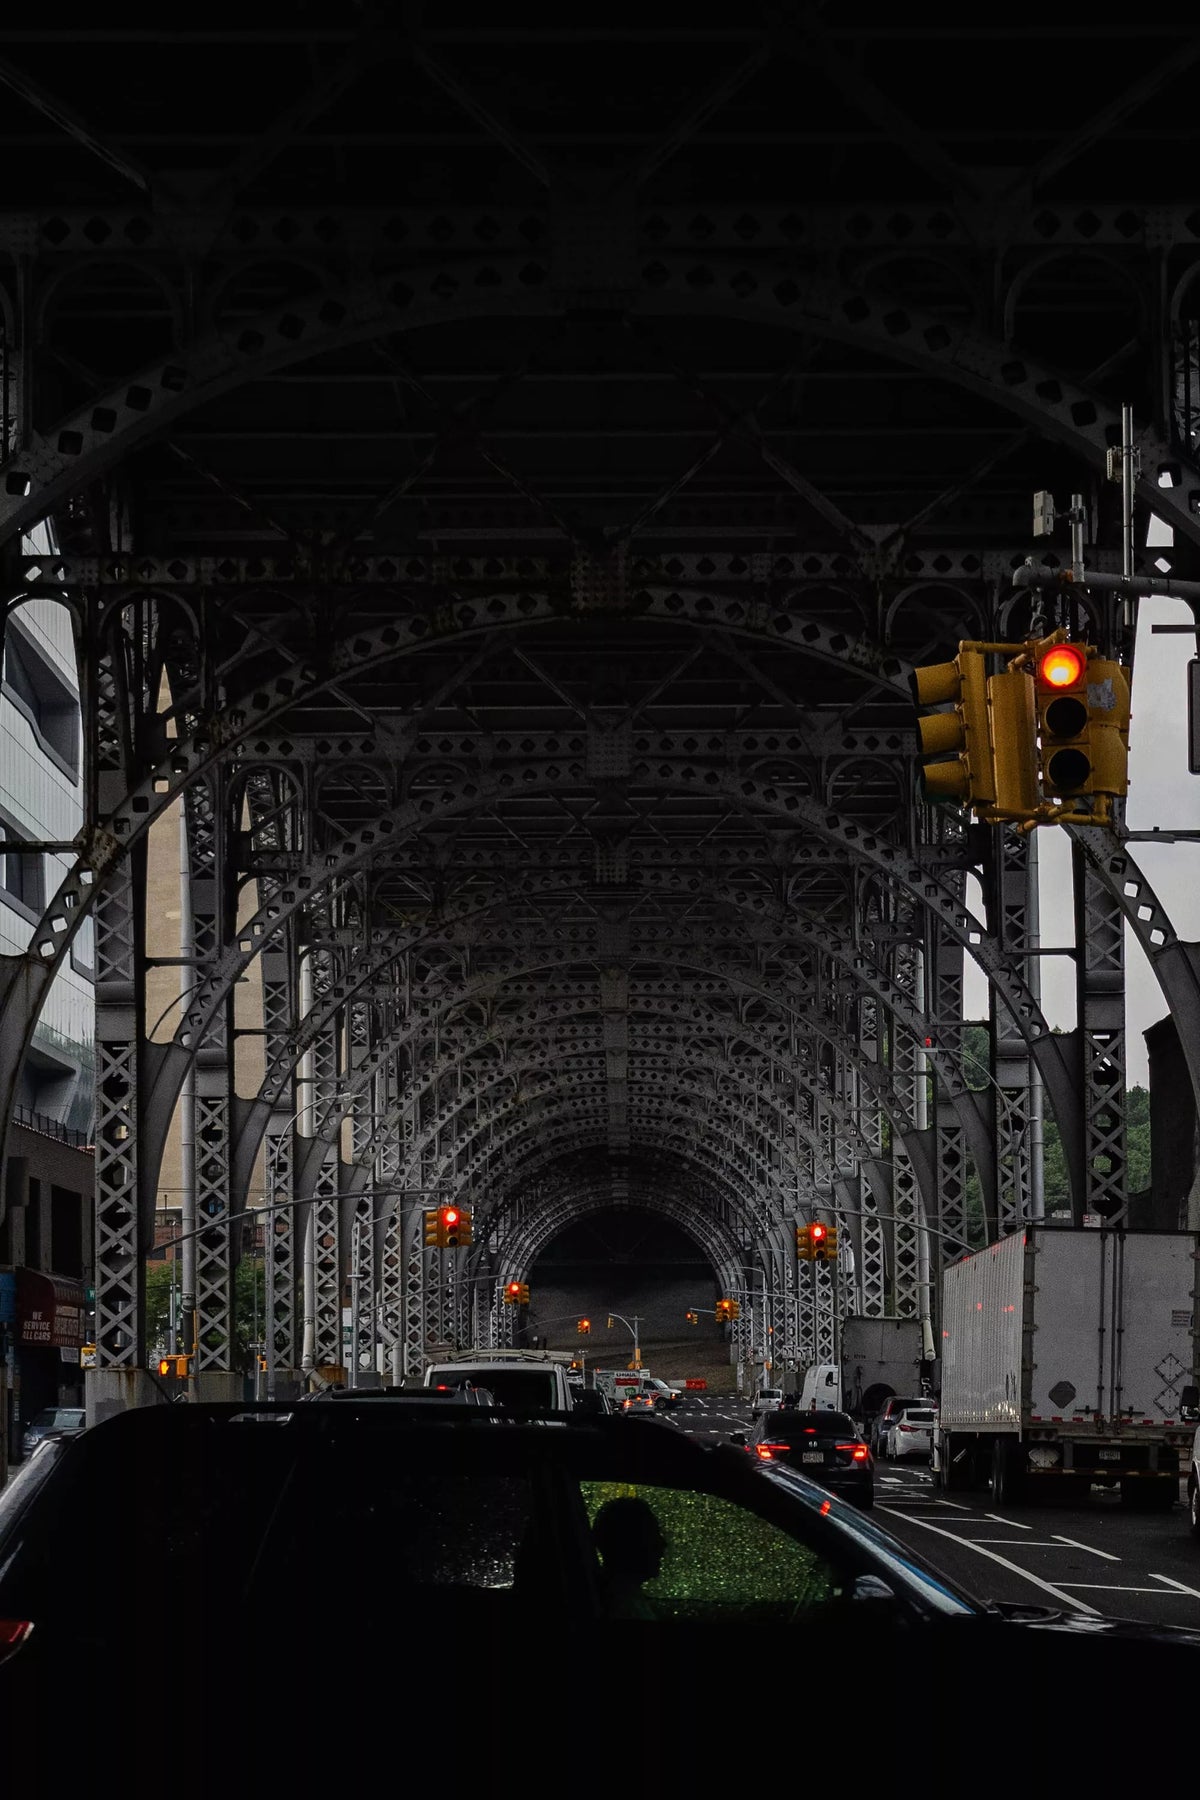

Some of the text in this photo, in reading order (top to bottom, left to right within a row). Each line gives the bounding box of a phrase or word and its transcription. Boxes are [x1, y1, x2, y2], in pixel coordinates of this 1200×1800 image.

[32, 1311, 43, 1320] WE
[23, 1321, 51, 1331] SERVICE
[22, 1331, 33, 1340] ALL
[33, 1332, 51, 1341] CARS
